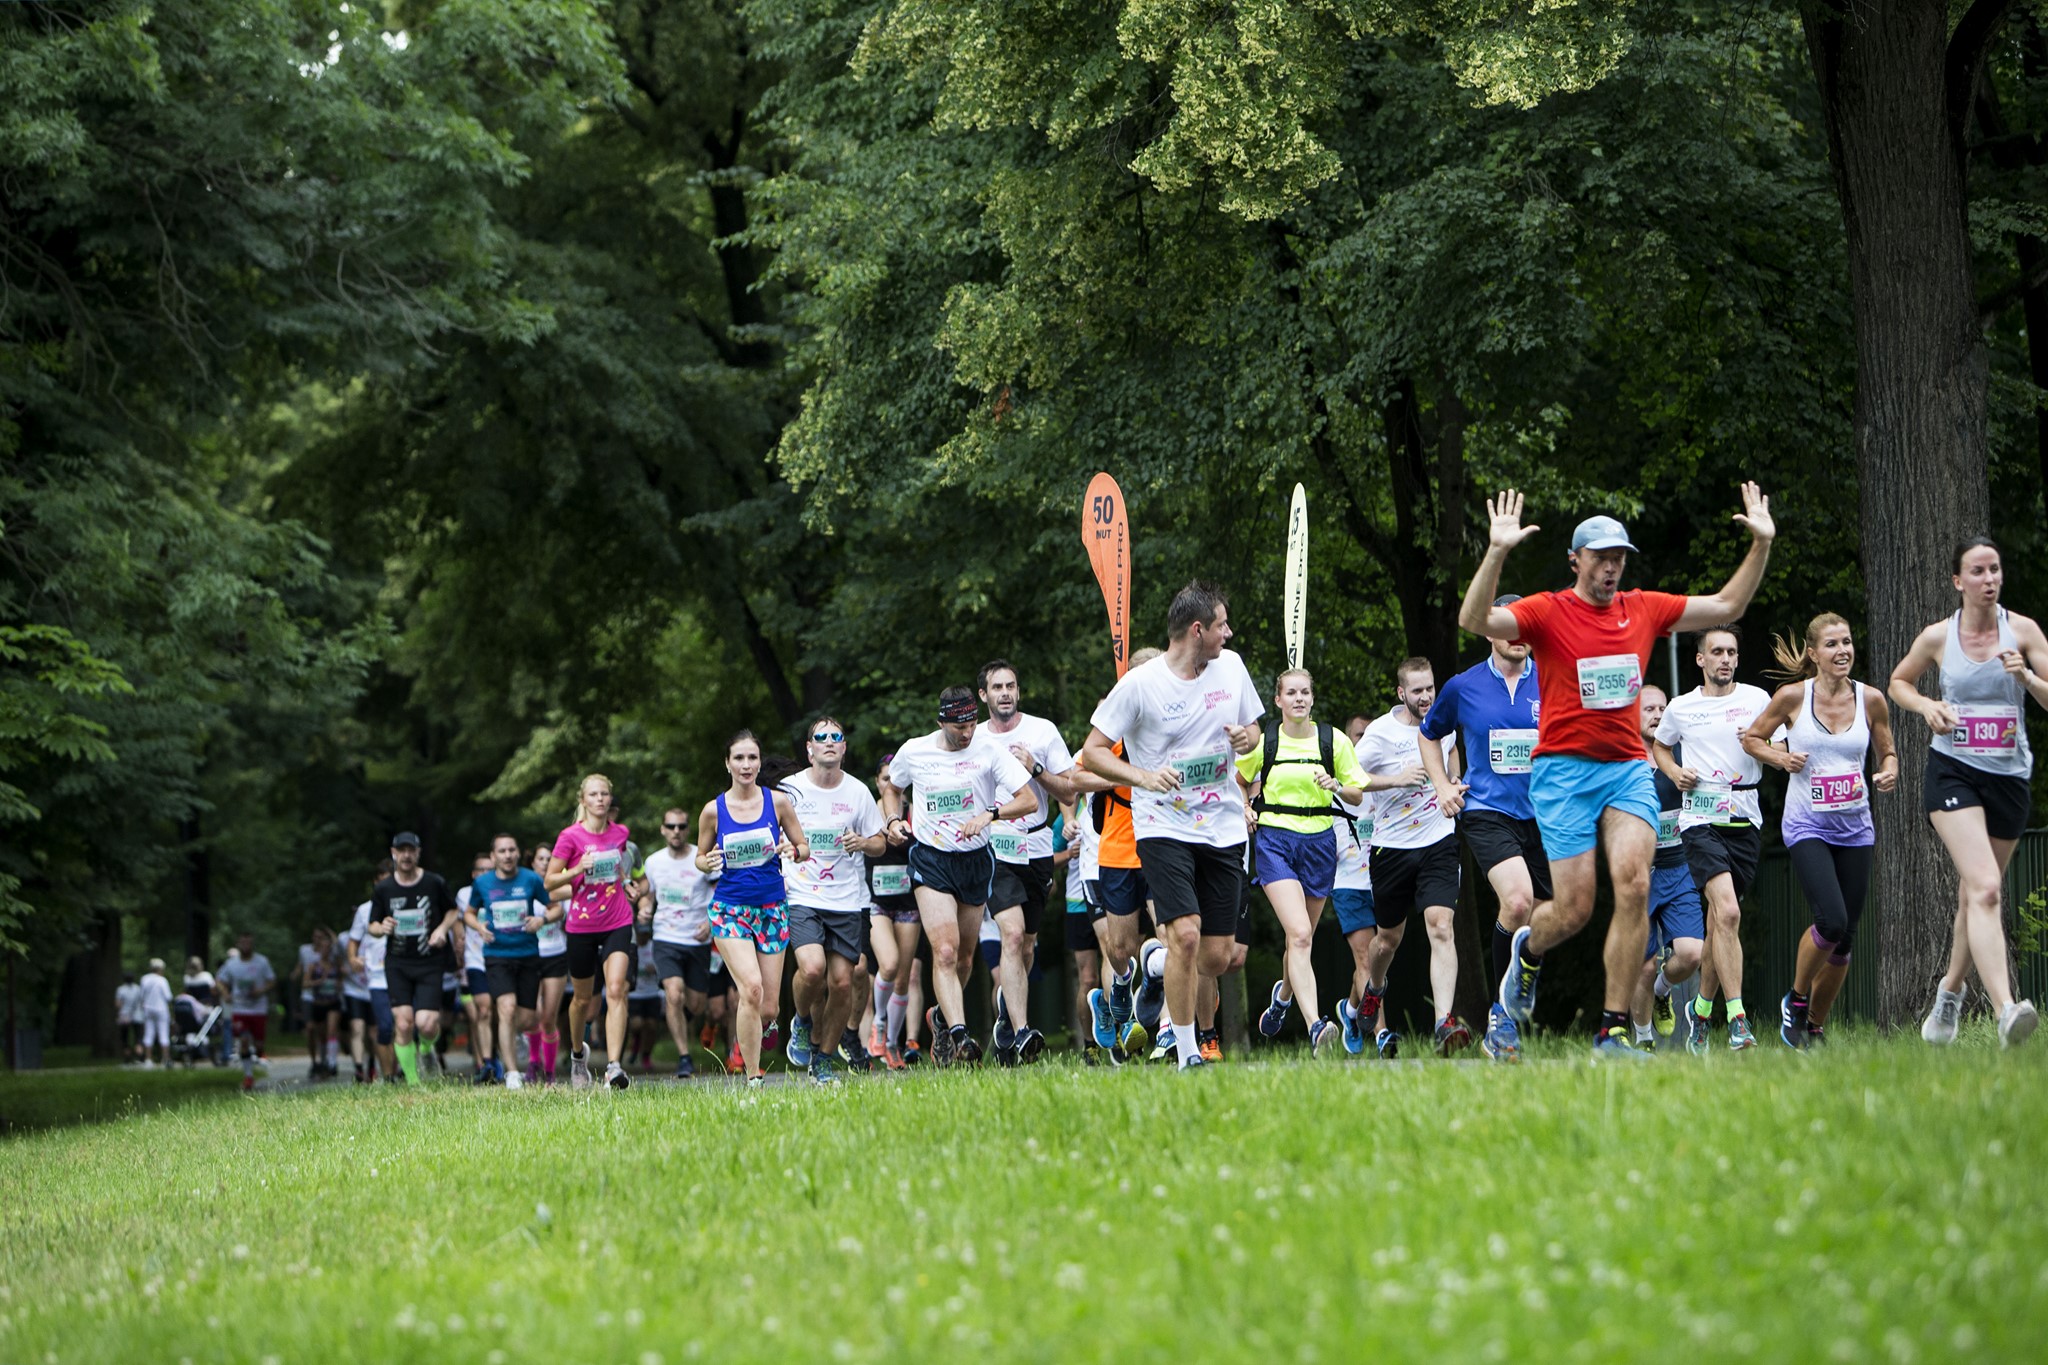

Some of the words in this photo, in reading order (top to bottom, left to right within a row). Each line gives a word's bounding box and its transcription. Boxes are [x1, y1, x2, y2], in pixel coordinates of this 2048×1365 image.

[1093, 495, 1114, 525] 50
[1112, 573, 1124, 662] ALPINE
[1288, 582, 1301, 669] ALPINE
[1597, 673, 1627, 691] 2556
[1974, 722, 1999, 740] 130
[1506, 744, 1531, 758] 2315
[1186, 761, 1214, 779] 2077
[1827, 779, 1851, 797] 790
[937, 794, 962, 808] 2053
[1694, 795, 1716, 809] 2107
[811, 833, 834, 844] 2382
[995, 838, 1016, 850] 2104
[737, 842, 761, 857] 2499
